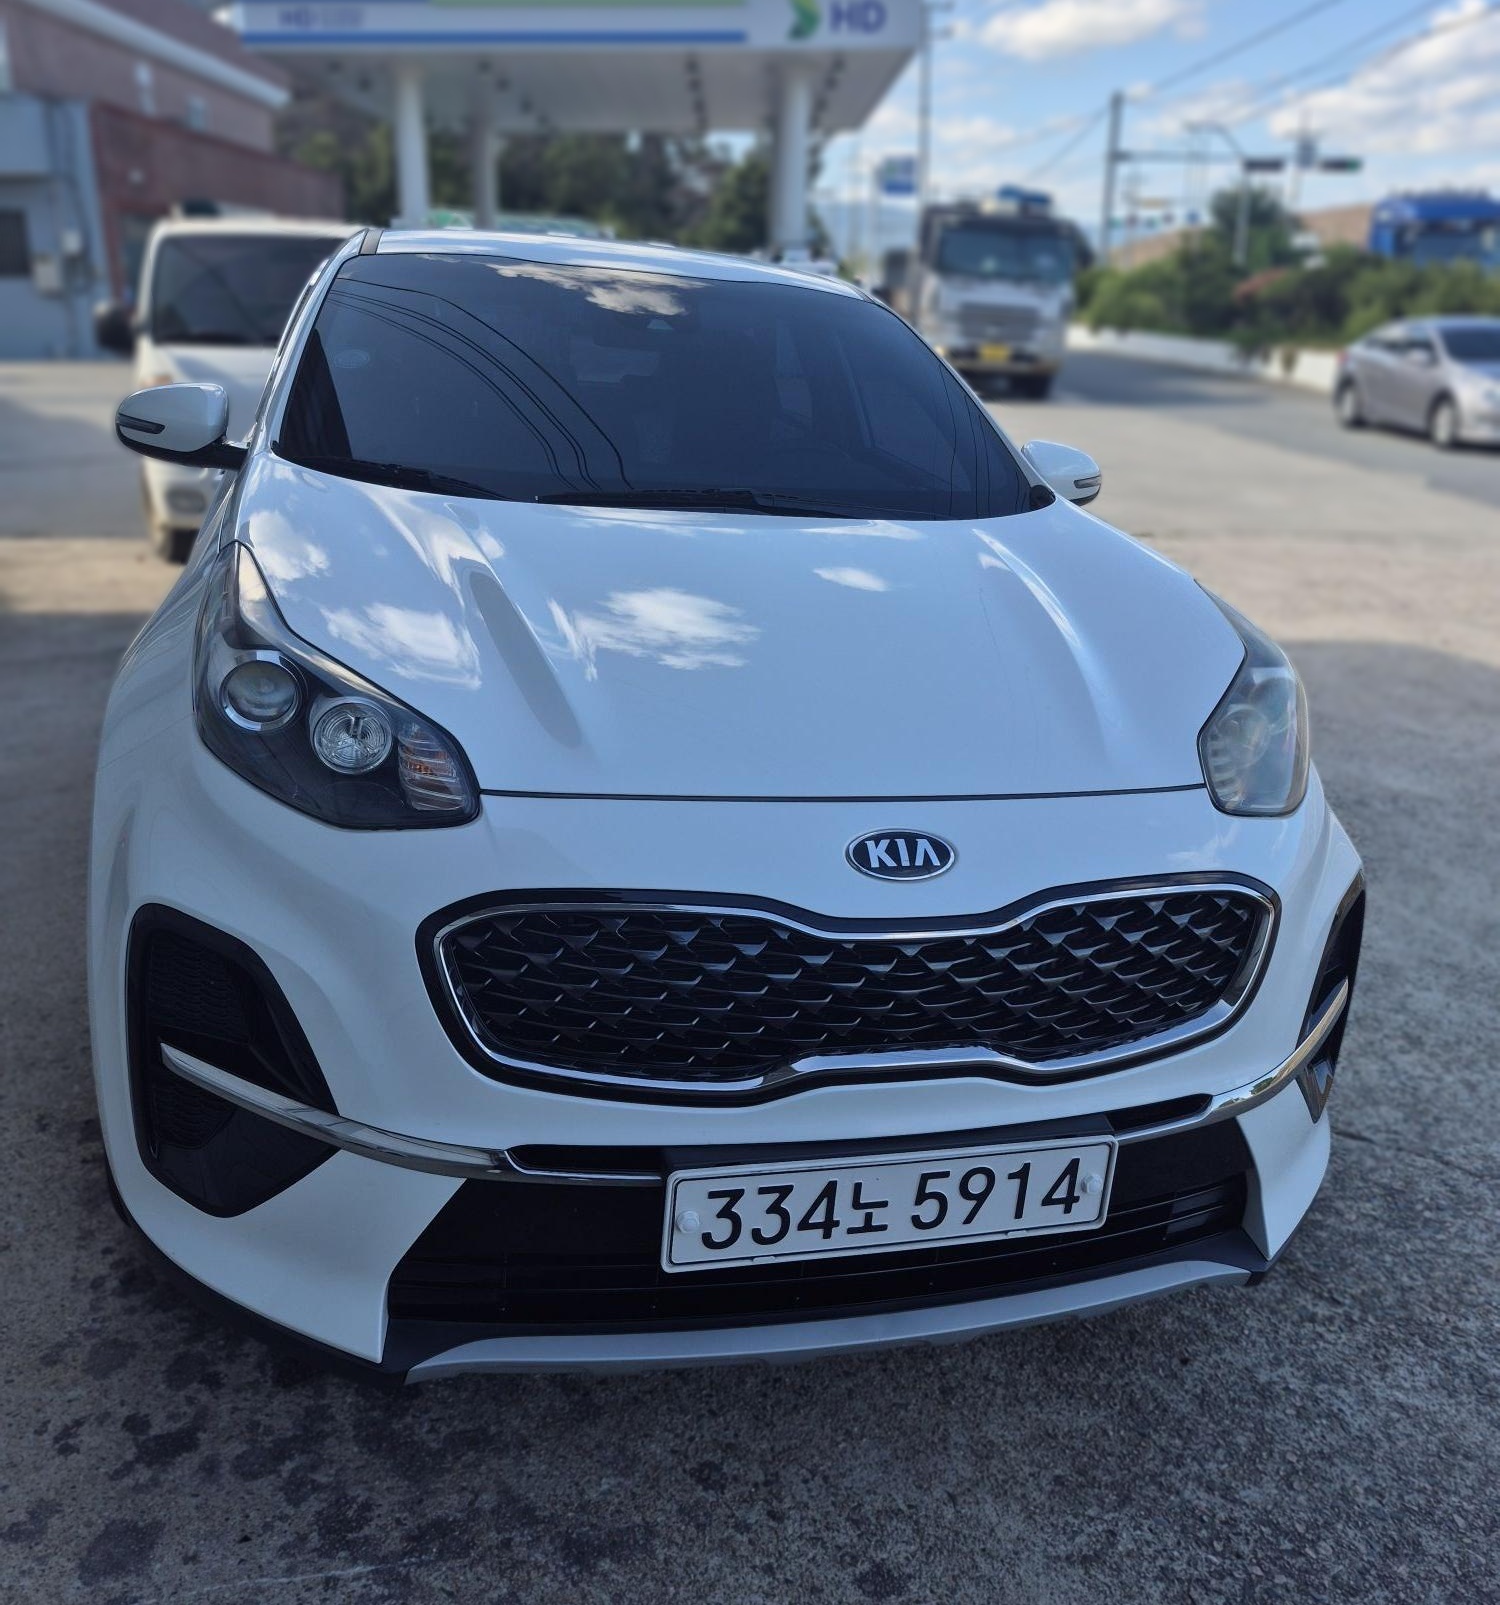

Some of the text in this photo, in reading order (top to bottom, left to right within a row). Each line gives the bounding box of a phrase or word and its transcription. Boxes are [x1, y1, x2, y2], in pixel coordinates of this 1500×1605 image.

[865, 839, 940, 868] KIA
[702, 1158, 1080, 1250] 334노 5914
